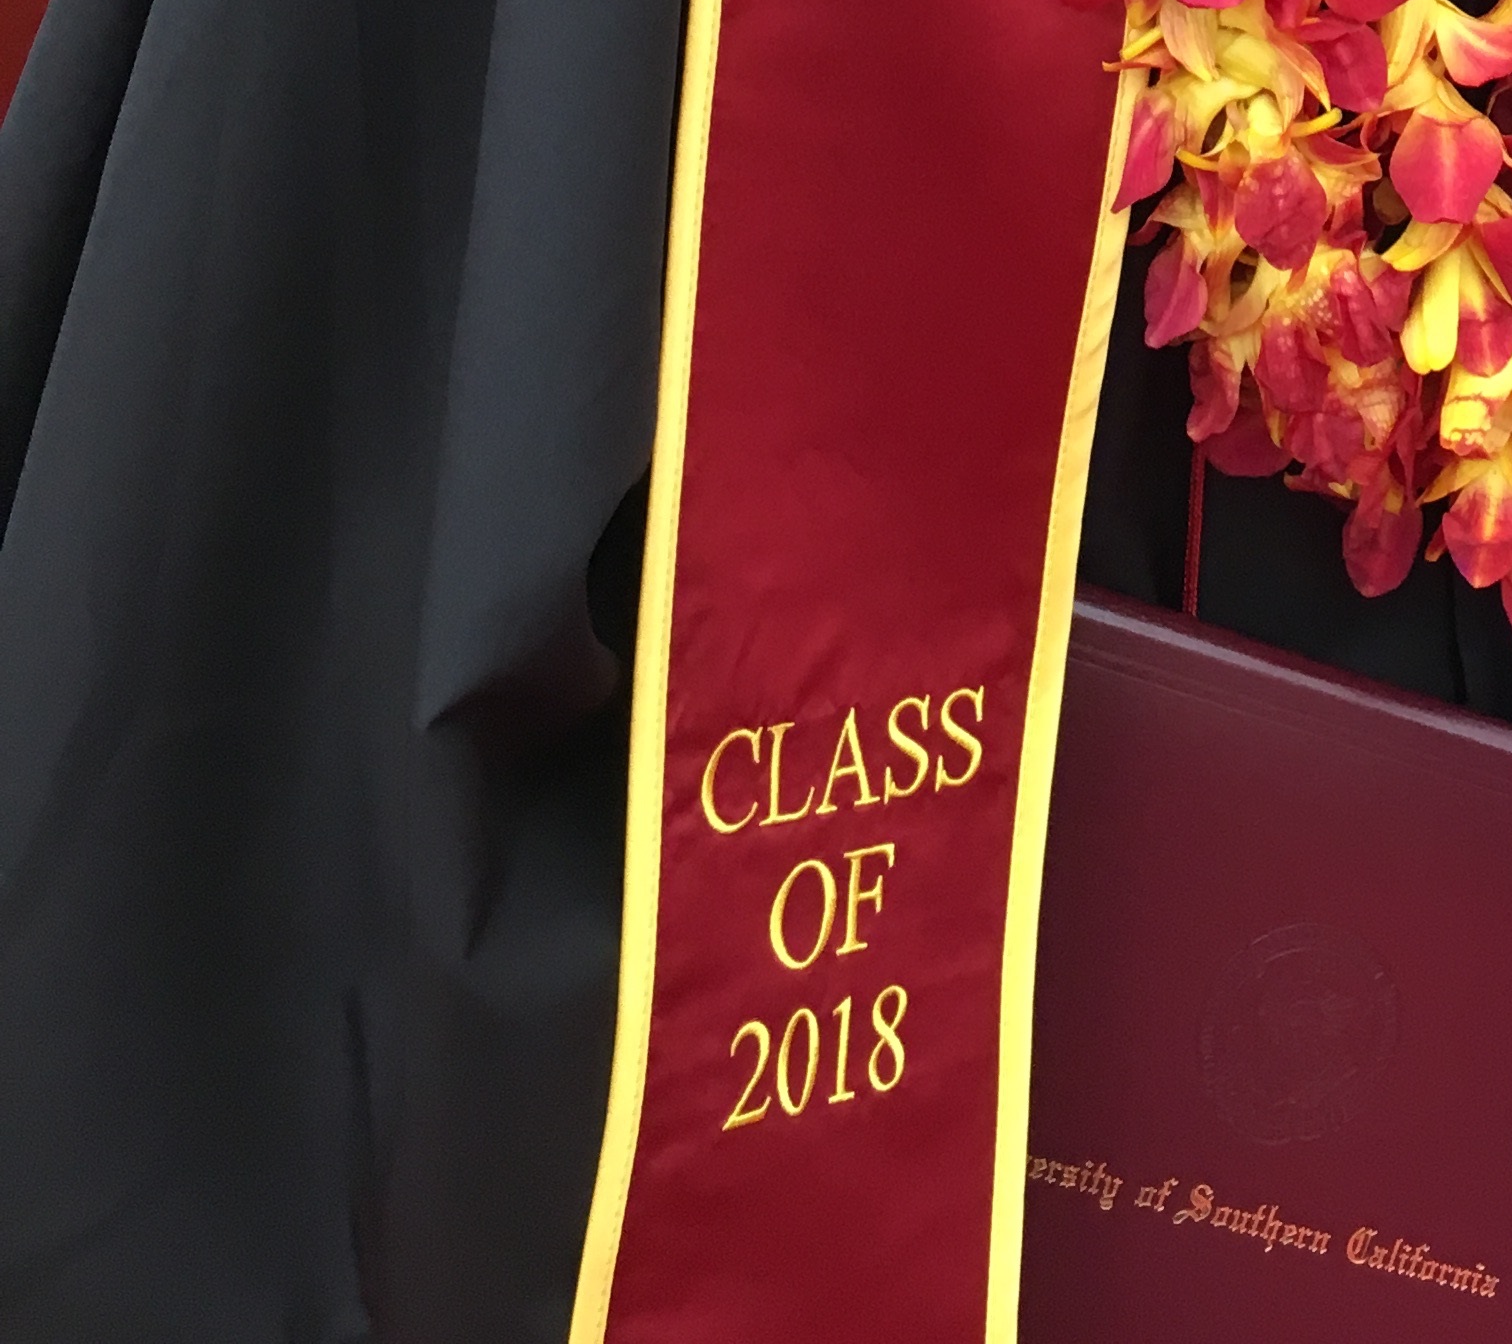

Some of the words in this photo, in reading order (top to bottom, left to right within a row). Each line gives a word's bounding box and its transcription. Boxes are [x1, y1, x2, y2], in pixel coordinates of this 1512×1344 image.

[701, 685, 984, 834] CLASS
[769, 842, 895, 970] OF
[722, 985, 908, 1131] 2018
[1134, 1177, 1179, 1212] of
[1172, 1184, 1332, 1253] Southern
[1346, 1227, 1500, 1298] California
